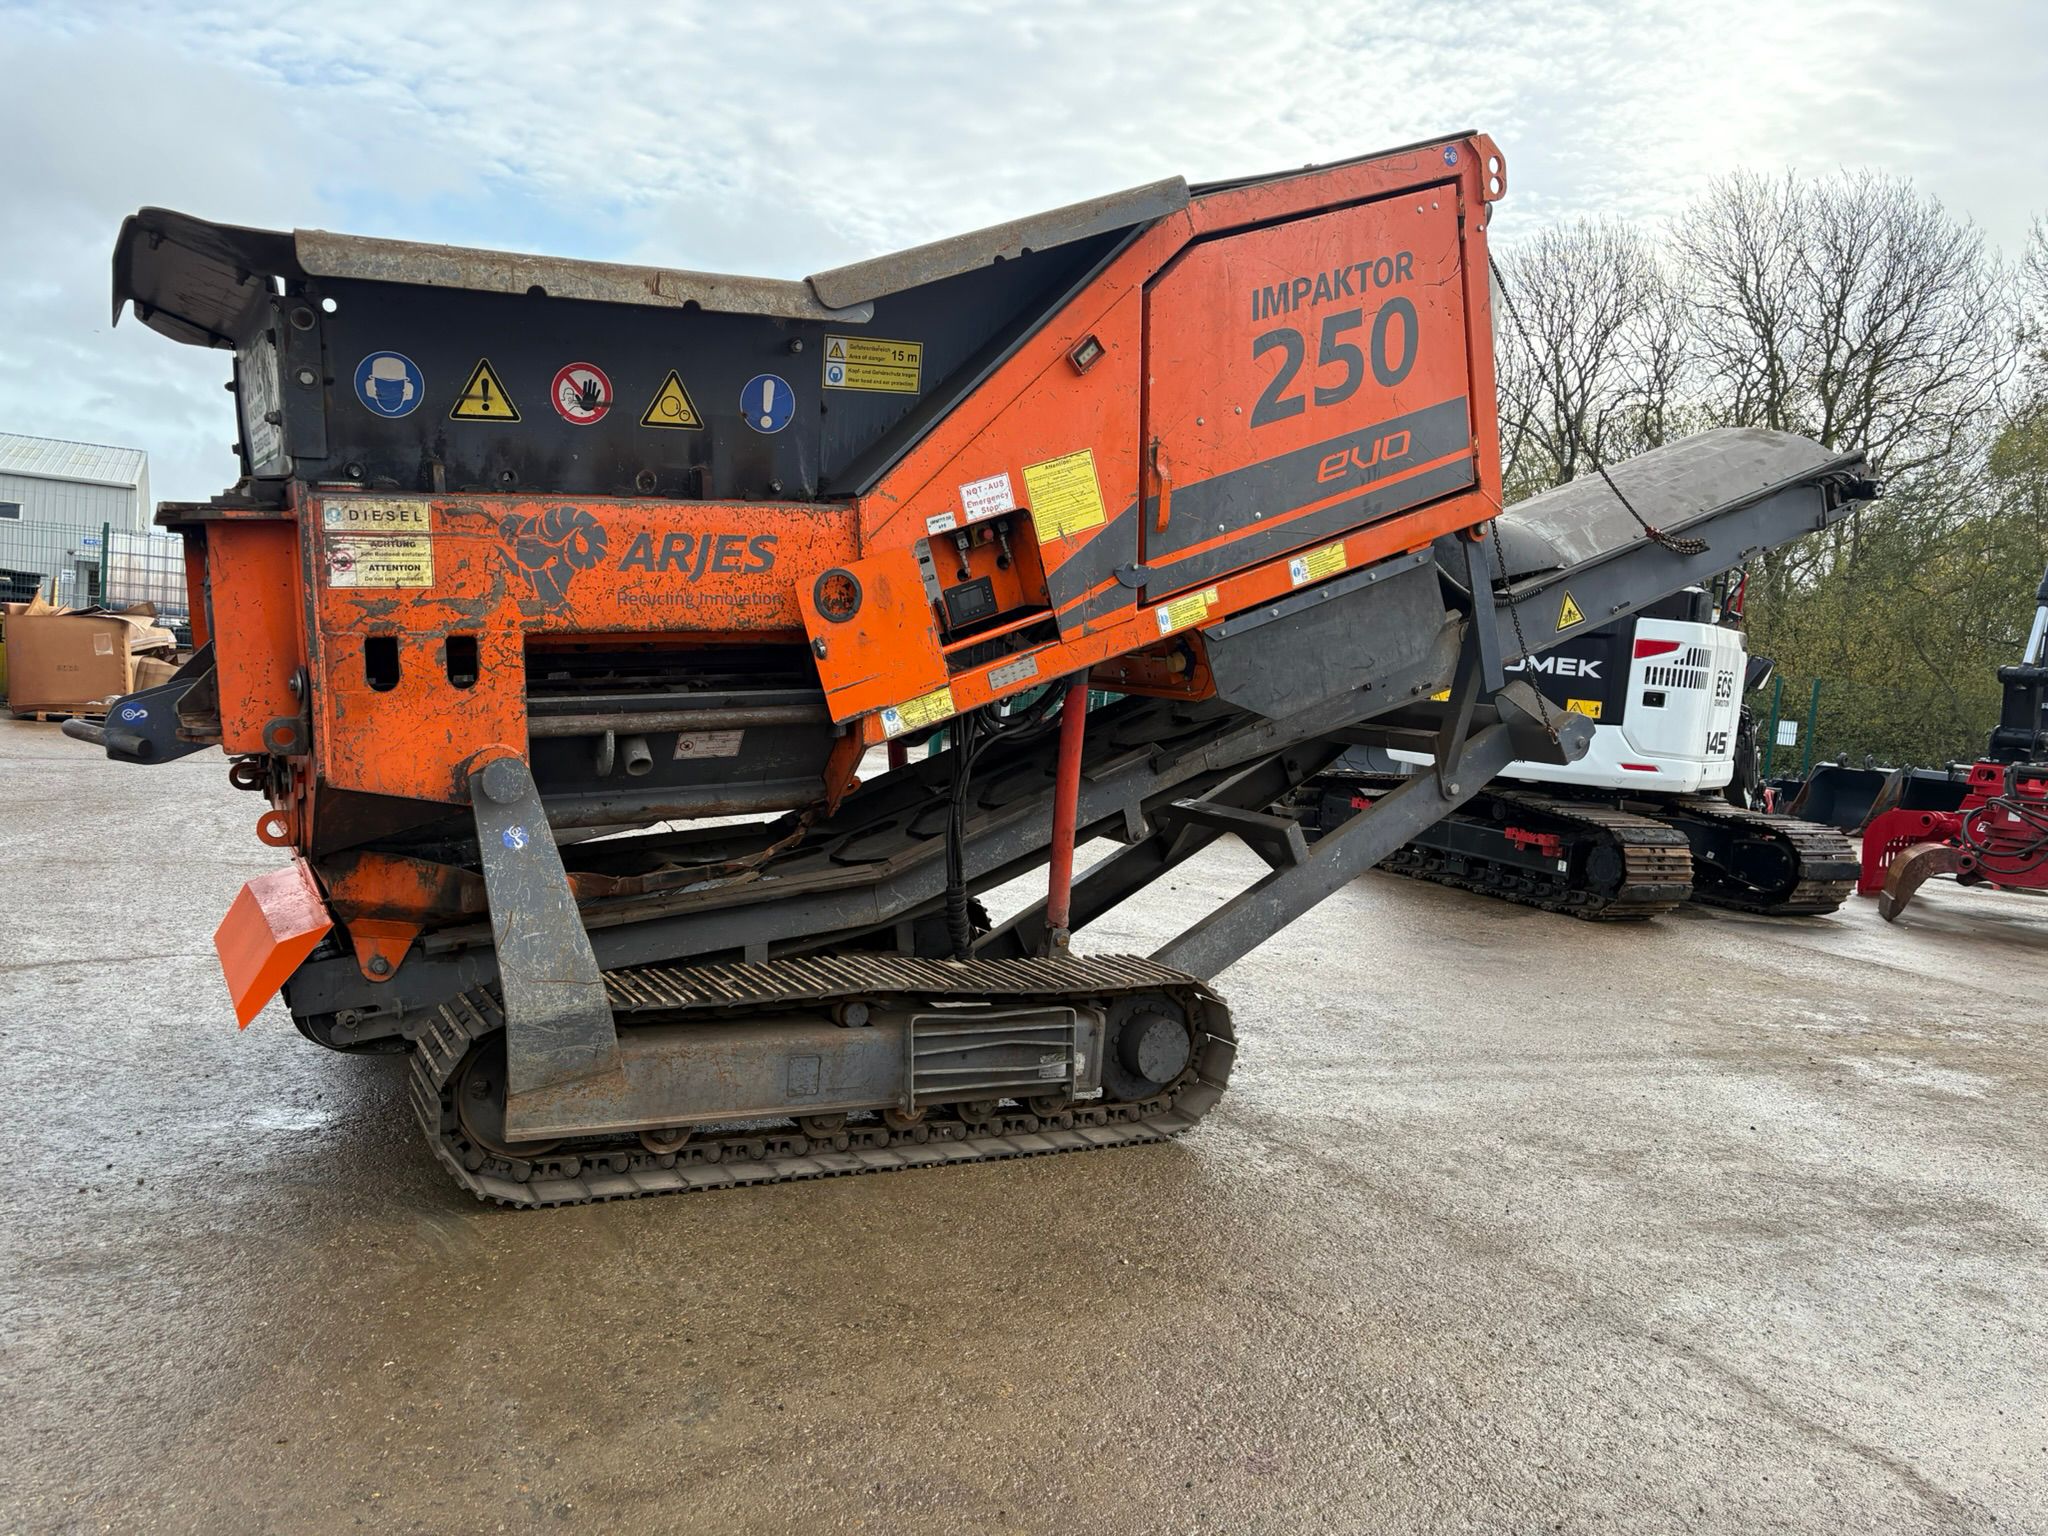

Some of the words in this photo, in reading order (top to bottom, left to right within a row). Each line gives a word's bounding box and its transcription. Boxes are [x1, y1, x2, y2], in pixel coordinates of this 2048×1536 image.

[1252, 251, 1414, 321] IMPAKTOR
[892, 350, 904, 361] 15
[907, 353, 917, 362] m
[1250, 296, 1418, 429] 250
[1317, 430, 1411, 483] evo
[967, 492, 1009, 508] Emergency
[981, 504, 999, 514] Stop
[349, 510, 422, 522] DIESEL
[617, 533, 778, 582] ARJES
[617, 592, 695, 609] Recycling
[1705, 732, 1728, 755] 145
